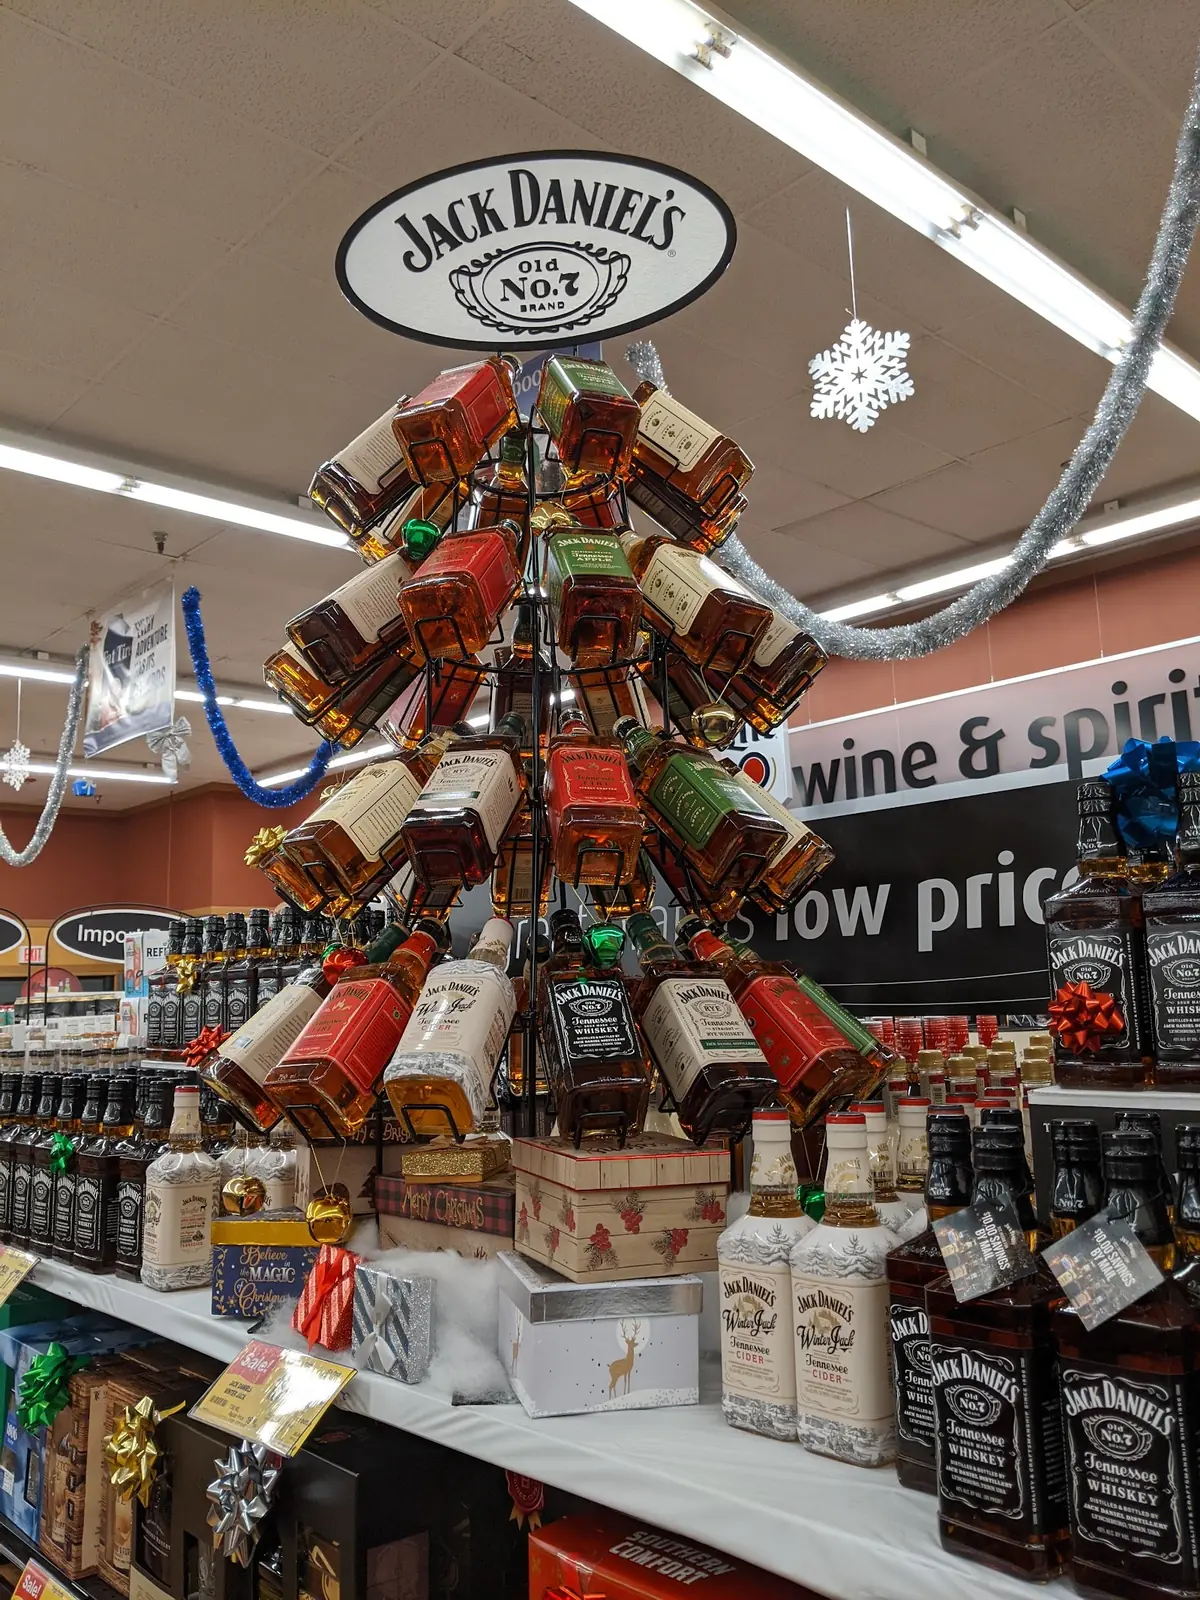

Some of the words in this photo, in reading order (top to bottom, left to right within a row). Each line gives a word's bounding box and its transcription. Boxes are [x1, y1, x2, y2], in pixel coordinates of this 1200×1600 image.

[394, 188, 508, 273] JACK
[507, 168, 686, 252] DANIEL'S
[518, 258, 559, 274] Old
[520, 301, 565, 312] BRAND
[556, 537, 581, 547] JACK
[580, 536, 620, 549] DANIEL'S
[134, 623, 168, 658] ADVENTURE
[437, 759, 461, 770] JACK
[462, 755, 498, 768] DANIEL'S
[561, 752, 584, 764] JACK
[584, 751, 622, 766] DANIEL'S
[792, 737, 938, 807] wine
[958, 716, 1006, 780] &
[23, 948, 43, 962] EXIT
[1050, 943, 1077, 970] JACK
[1077, 939, 1127, 967] DANIEL'S
[1147, 941, 1178, 967] JACK
[1076, 971, 1098, 980] No.7
[1176, 968, 1200, 977] No.7
[425, 983, 447, 998] JACK
[447, 981, 481, 998] DANIEL'S
[554, 988, 581, 1005] JACK
[580, 984, 624, 1002] DANIEL'S
[676, 988, 697, 1005] JACK
[696, 985, 736, 1005] DANIEL'S
[571, 1016, 618, 1026] Tennessee
[574, 1026, 619, 1035] WHISKEY
[700, 1018, 740, 1027] Tennessee
[975, 1228, 988, 1240] BY
[981, 1211, 998, 1237] $10.00
[239, 1245, 288, 1266] Believe
[979, 1240, 995, 1261] MAIL
[989, 1235, 1011, 1271] SAVINGS
[1090, 1247, 1105, 1260] BY
[1093, 1228, 1114, 1252] $10.00
[1107, 1251, 1136, 1287] SAVINGS
[240, 1267, 249, 1277] the
[249, 1266, 296, 1284] MAGIC
[1097, 1258, 1117, 1282] MAIL
[234, 1278, 288, 1317] Christma
[723, 1279, 742, 1299] JACK
[742, 1276, 777, 1308] DANIEL'S
[797, 1292, 819, 1314] JACK
[817, 1289, 855, 1323] DANIEL'S
[721, 1308, 755, 1333] Winter
[750, 1309, 778, 1337] Jack
[890, 1316, 917, 1341] JACK
[729, 1335, 770, 1356] Tennessee
[796, 1324, 831, 1350] Winter
[827, 1325, 856, 1355] Jack
[240, 1353, 274, 1374] Sale!
[736, 1350, 764, 1364] CIDER
[805, 1353, 849, 1375] Tennessee
[812, 1369, 842, 1384] CIDER
[931, 1358, 962, 1386] JACK
[961, 1353, 1020, 1404] DANIEL'S
[959, 1397, 986, 1413] No.7
[964, 1392, 978, 1400] Old
[1021, 1388, 1029, 1409] SINCE
[1063, 1385, 1103, 1416] JACK
[1102, 1380, 1176, 1435] DANIEL'S
[946, 1418, 1005, 1447] Tennessee
[1100, 1428, 1133, 1446] No.7
[1106, 1423, 1124, 1433] Old
[960, 1439, 974, 1447] SOUR
[975, 1443, 992, 1452] MASH
[1024, 1411, 1034, 1472] CRAFTSMANSHIP
[948, 1443, 1006, 1468] WHISKEY
[945, 1465, 959, 1474] JACK
[958, 1468, 978, 1480] DANIEL
[979, 1475, 1013, 1489] DISTILLERY
[1084, 1451, 1158, 1484] Tennessee
[1181, 1443, 1193, 1511] CRAFTSMANSHIP
[1086, 1478, 1159, 1507] WHISKEY
[1101, 1474, 1119, 1483] SOUR
[1121, 1479, 1141, 1489] MASH
[1029, 1480, 1037, 1513] QUALITY
[1083, 1502, 1100, 1512] JACK
[1100, 1507, 1125, 1520] DANIEL
[1126, 1513, 1169, 1531] DISTILLERY
[1089, 1496, 1118, 1509] DISTILLED
[1123, 1505, 1150, 1518] BOTTLED
[1150, 1512, 1159, 1520] BY
[1147, 1527, 1161, 1538] USA
[1188, 1519, 1197, 1555] QUALITY
[608, 1541, 709, 1585] COMFORT
[625, 1531, 737, 1576] SOUTHERN
[22, 1574, 42, 1599] Sale!
